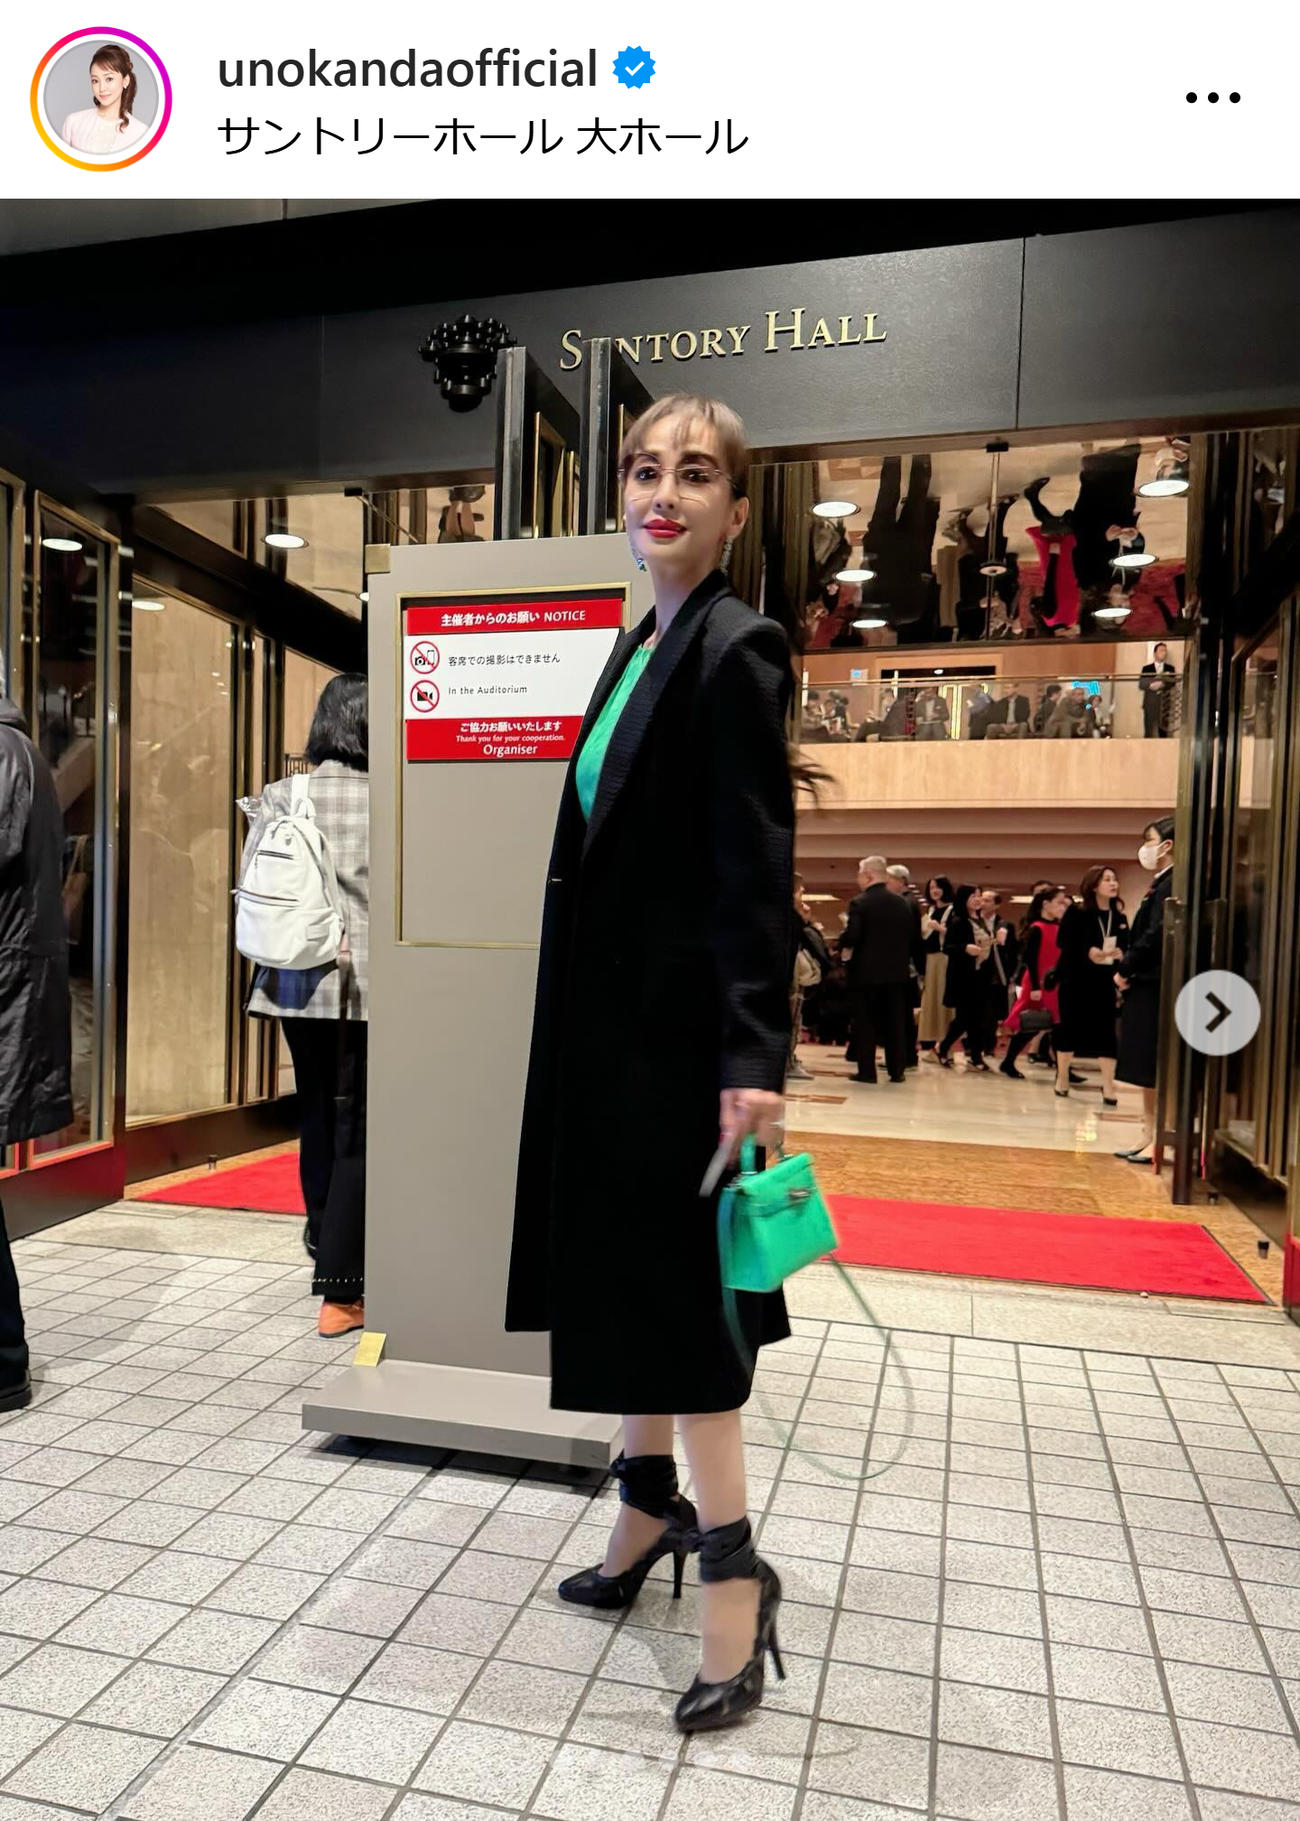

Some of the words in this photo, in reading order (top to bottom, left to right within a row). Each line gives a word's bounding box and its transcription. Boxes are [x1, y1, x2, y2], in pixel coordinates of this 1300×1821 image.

[559, 325, 751, 371] SNTORY
[764, 308, 887, 353] HALL
[441, 611, 540, 627] 主催者からのお願い
[543, 610, 586, 622] NOTICE
[448, 653, 561, 667] 客席での撮影はできません
[448, 687, 457, 695] In
[460, 686, 474, 695] the
[477, 685, 528, 695] Auditorium
[460, 720, 562, 733] ご協力お願いいたします
[456, 735, 477, 743] Thank
[478, 736, 491, 744] you
[504, 736, 521, 744] your
[483, 743, 538, 758] Organiser
